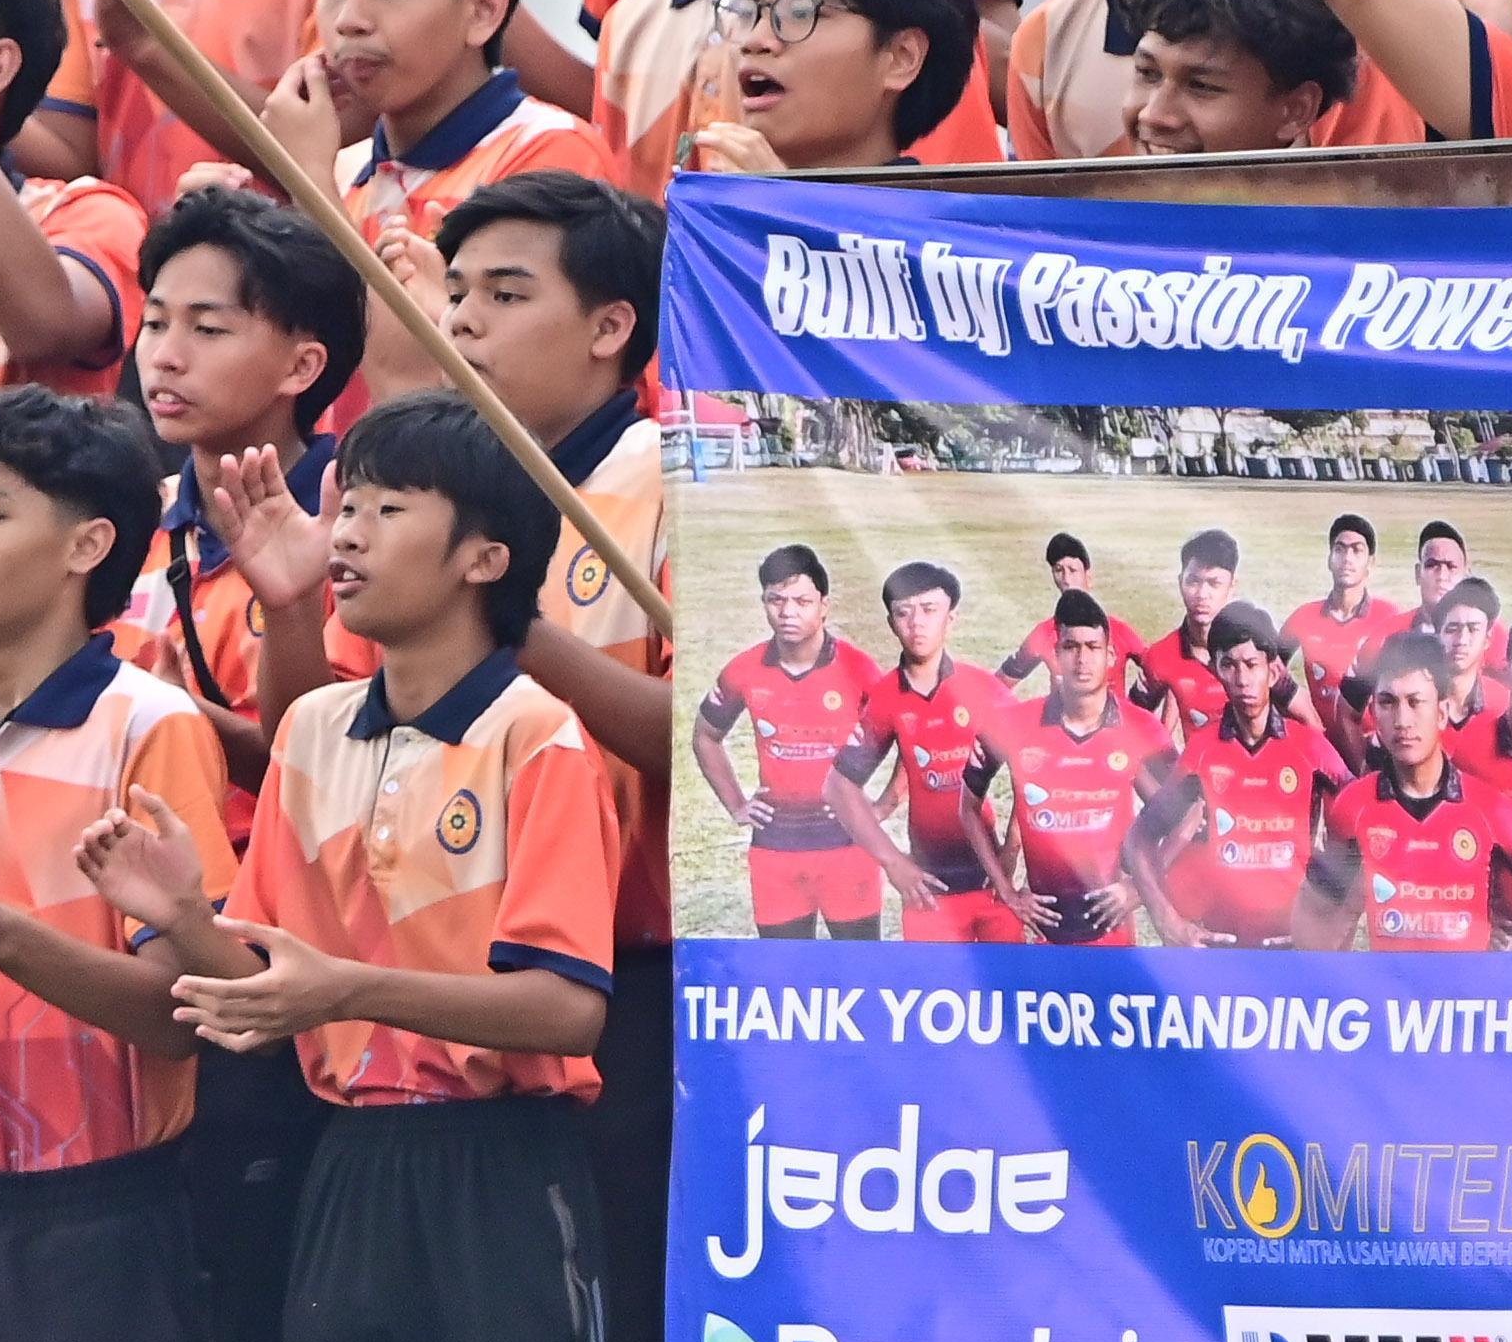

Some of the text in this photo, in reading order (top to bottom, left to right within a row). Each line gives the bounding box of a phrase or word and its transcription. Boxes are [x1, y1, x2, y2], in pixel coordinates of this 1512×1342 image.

[768, 233, 920, 340] Built
[921, 244, 1010, 356] by
[1019, 256, 1309, 362] Passion,
[684, 986, 864, 1043] THANK
[879, 988, 1004, 1045] YOU
[1017, 992, 1101, 1048] FOR
[1106, 995, 1371, 1052] STANDING
[706, 1104, 1069, 1280] jedae
[1203, 1238, 1285, 1263] KOPERASI
[1288, 1240, 1346, 1263] MITRA
[1347, 1241, 1457, 1265] USAHAWAN
